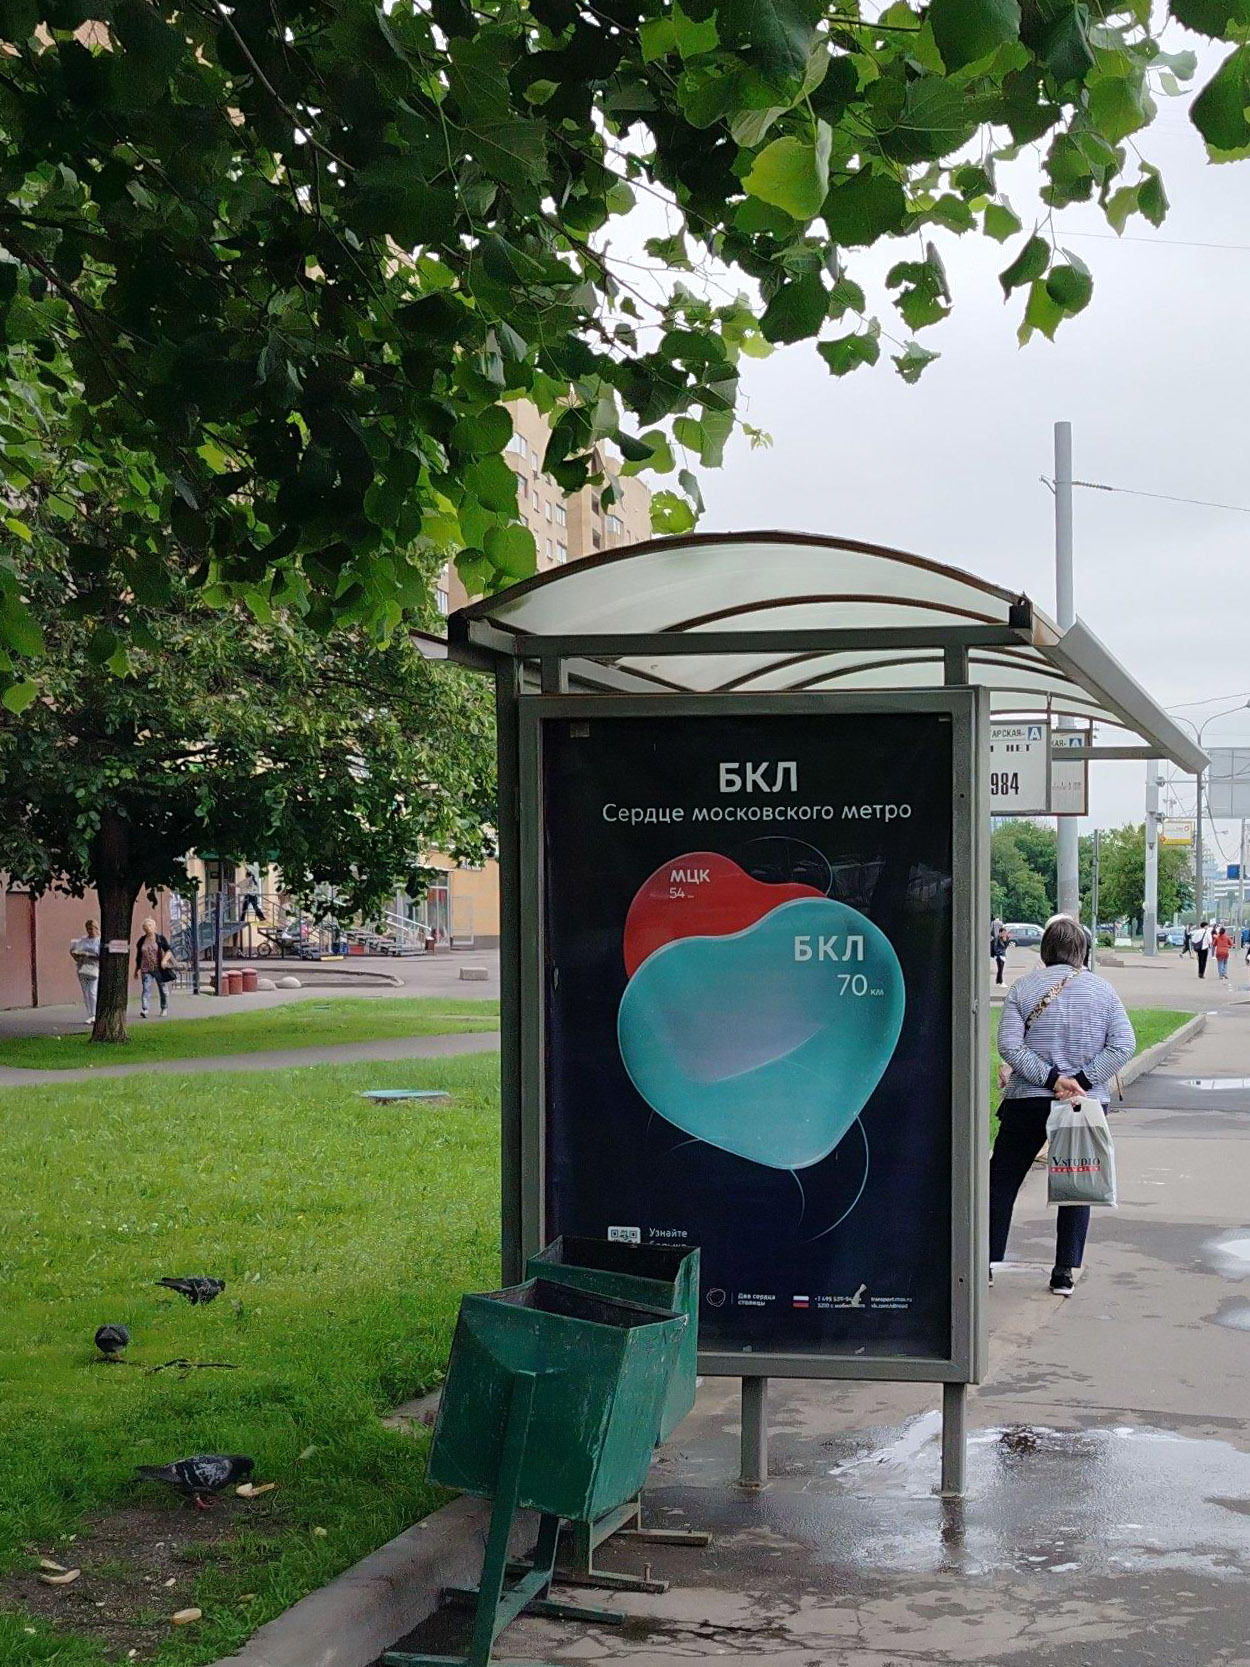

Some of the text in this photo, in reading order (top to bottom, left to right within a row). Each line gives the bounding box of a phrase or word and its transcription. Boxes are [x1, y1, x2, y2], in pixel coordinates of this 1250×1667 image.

[719, 761, 798, 793] БКЛ
[602, 803, 912, 826] Сердце московского метро
[670, 869, 710, 884] МЦК
[669, 887, 685, 899] 54
[794, 935, 864, 961] БКЛ
[837, 974, 868, 996] 70
[649, 1227, 688, 1238] Узнайте
